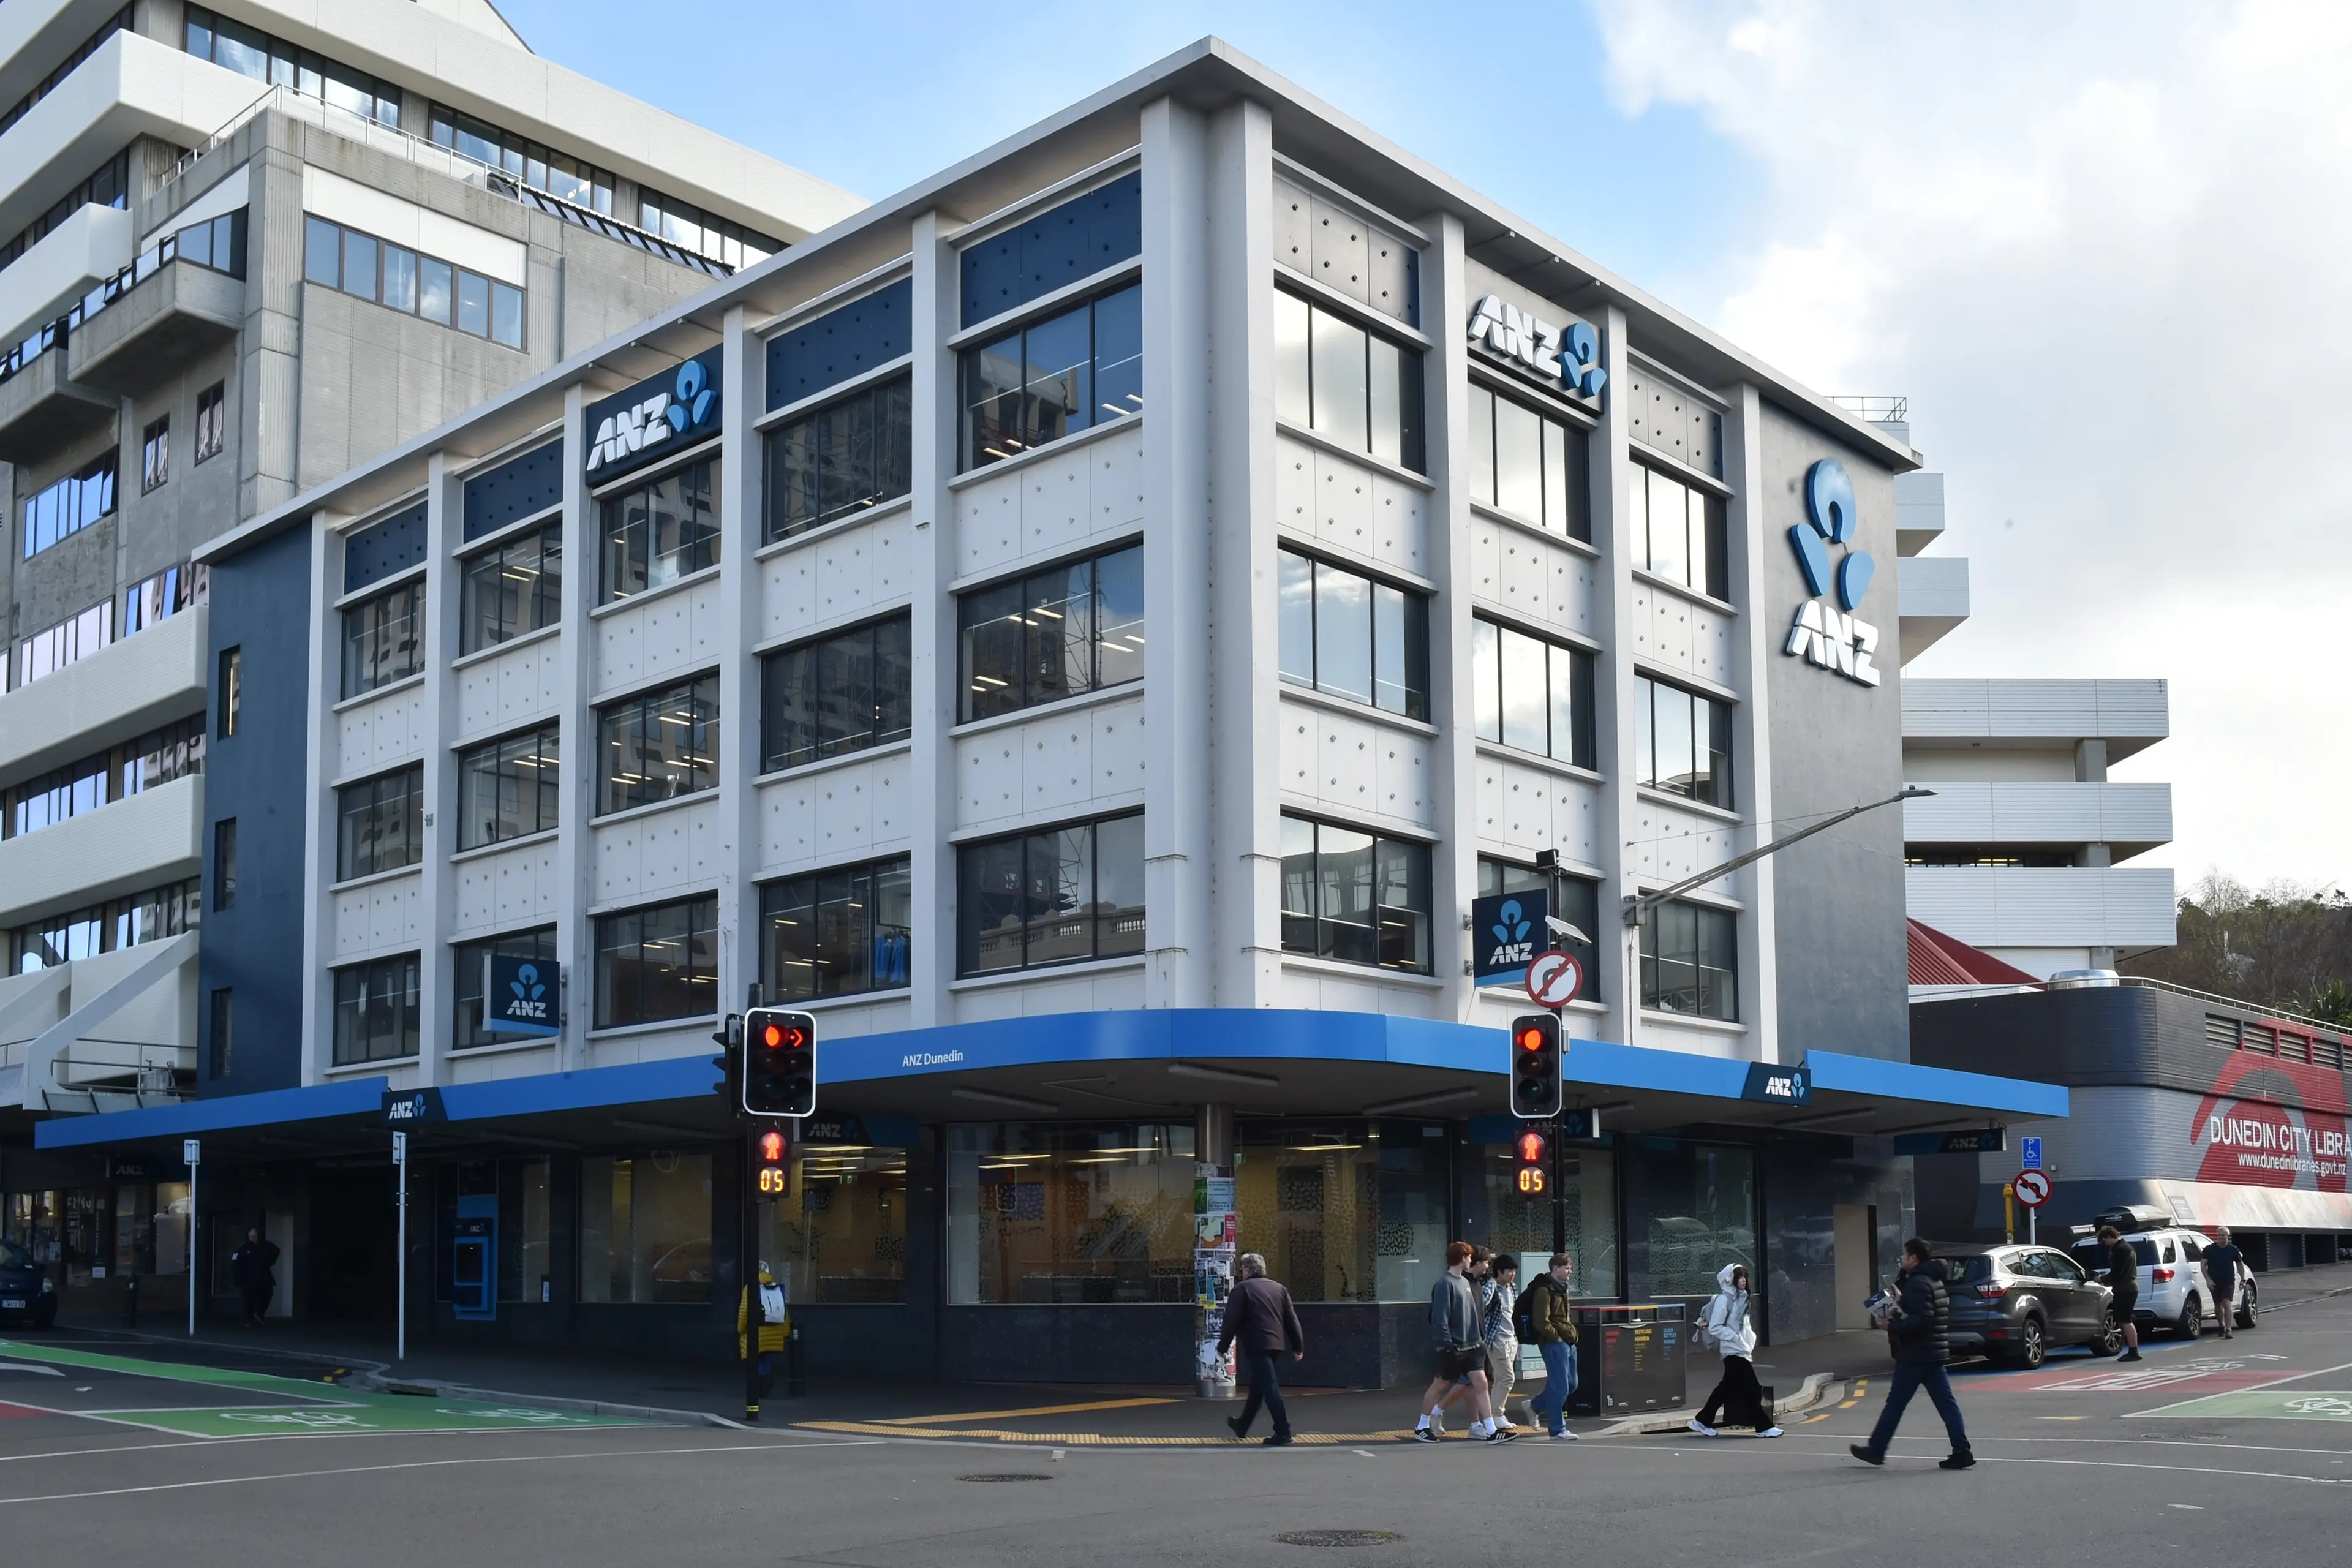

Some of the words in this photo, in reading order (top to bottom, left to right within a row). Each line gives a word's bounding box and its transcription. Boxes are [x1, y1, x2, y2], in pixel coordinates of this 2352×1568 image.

[1468, 295, 1562, 379] ANZ
[586, 392, 671, 472] ANZ
[1786, 600, 1880, 687] ANZ
[1489, 942, 1532, 965] ANZ
[507, 1000, 546, 1018] ANZ
[902, 1054, 922, 1067] ANZ
[924, 1049, 963, 1065] Dunedin
[1765, 1076, 1792, 1097] ANZ
[388, 1101, 413, 1120] ANZ
[809, 1123, 842, 1138] ANZ
[2210, 1116, 2276, 1150] DUNEDIN
[2279, 1125, 2311, 1153] CITY
[1948, 1137, 1979, 1149] ANZ
[116, 1164, 144, 1175] ANZ
[2237, 1152, 2347, 1177] www.dunedinlibraries.govt.nz
[760, 1170, 783, 1192] 05
[1520, 1170, 1543, 1191] 05
